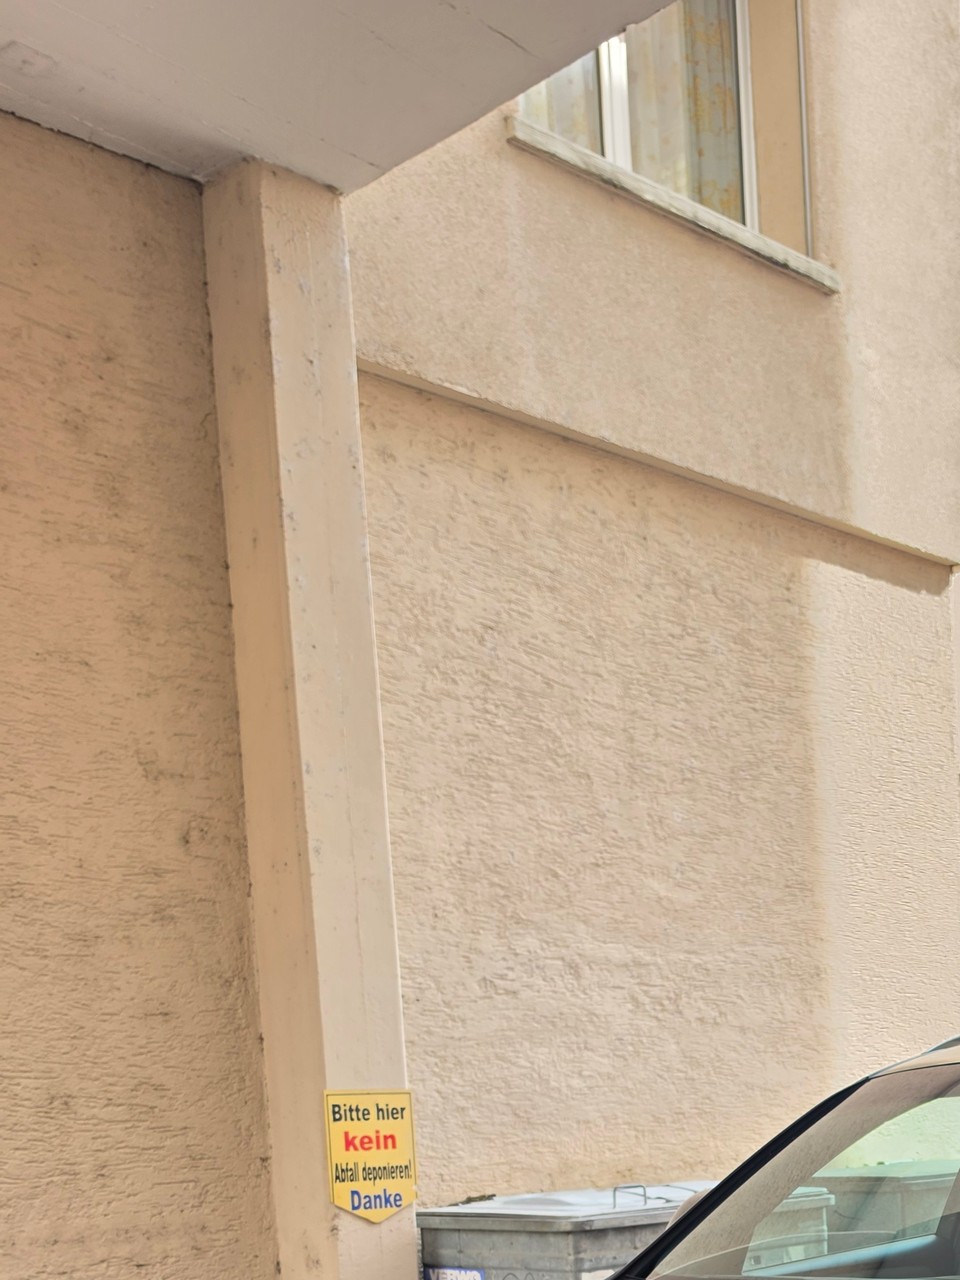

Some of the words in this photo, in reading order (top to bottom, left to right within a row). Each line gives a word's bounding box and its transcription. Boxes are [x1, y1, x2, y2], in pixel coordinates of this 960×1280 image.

[332, 1104, 371, 1122] Bitte
[376, 1103, 406, 1120] hier
[344, 1130, 397, 1152] kein
[335, 1162, 359, 1183] Abfall
[362, 1160, 412, 1186] deponieren!
[350, 1188, 403, 1210] Danke
